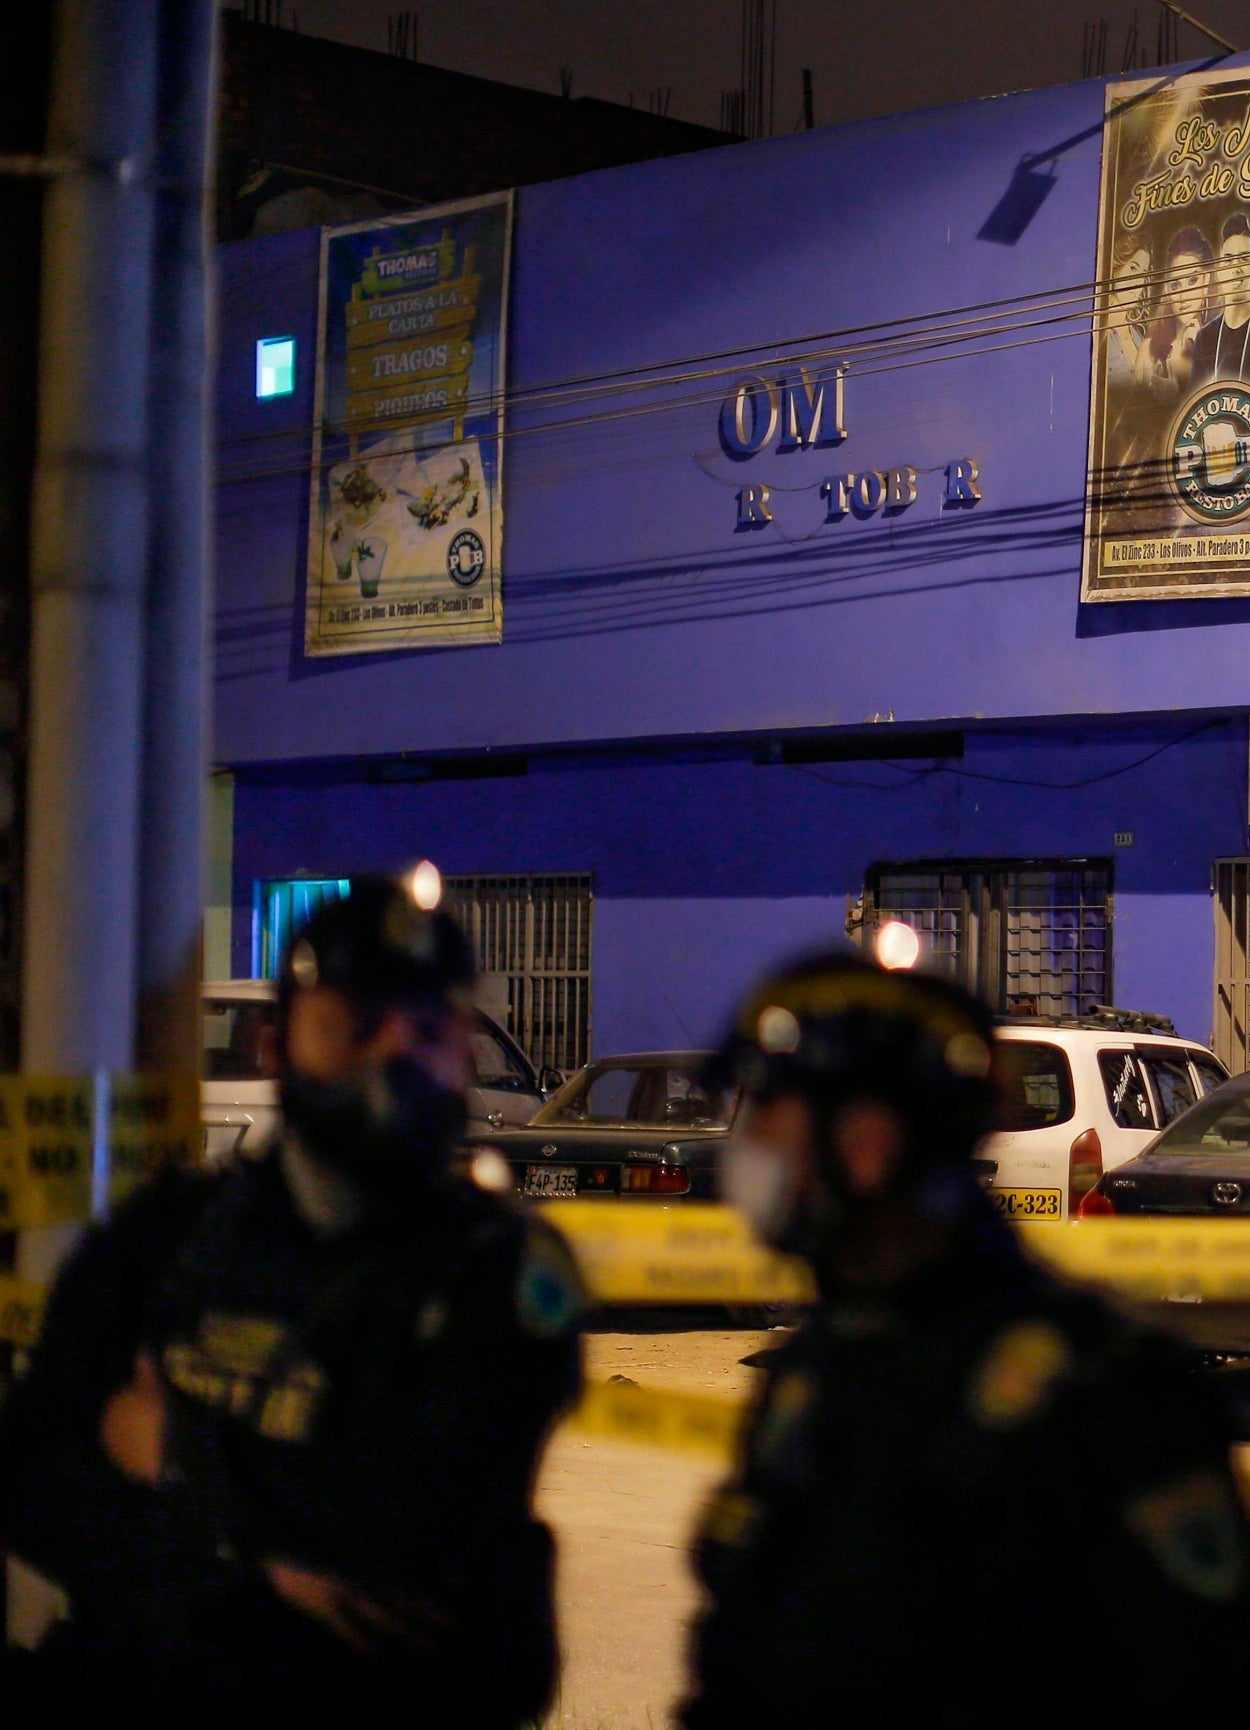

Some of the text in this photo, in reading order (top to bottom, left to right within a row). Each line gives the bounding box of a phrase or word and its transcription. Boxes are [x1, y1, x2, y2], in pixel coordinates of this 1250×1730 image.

[1169, 115, 1220, 166] Los
[1122, 169, 1197, 228] Fines
[1199, 163, 1235, 198] de
[378, 251, 437, 276] THOMAS
[372, 343, 448, 377] TRAGOS
[740, 458, 983, 523] R TOB R
[1160, 543, 1171, 558] Los
[1172, 541, 1191, 557] Olivos
[1196, 540, 1207, 556] Alt.
[1208, 540, 1238, 556] Paradero
[528, 1174, 576, 1192] F4P-135
[995, 1193, 1058, 1215] 2C-323
